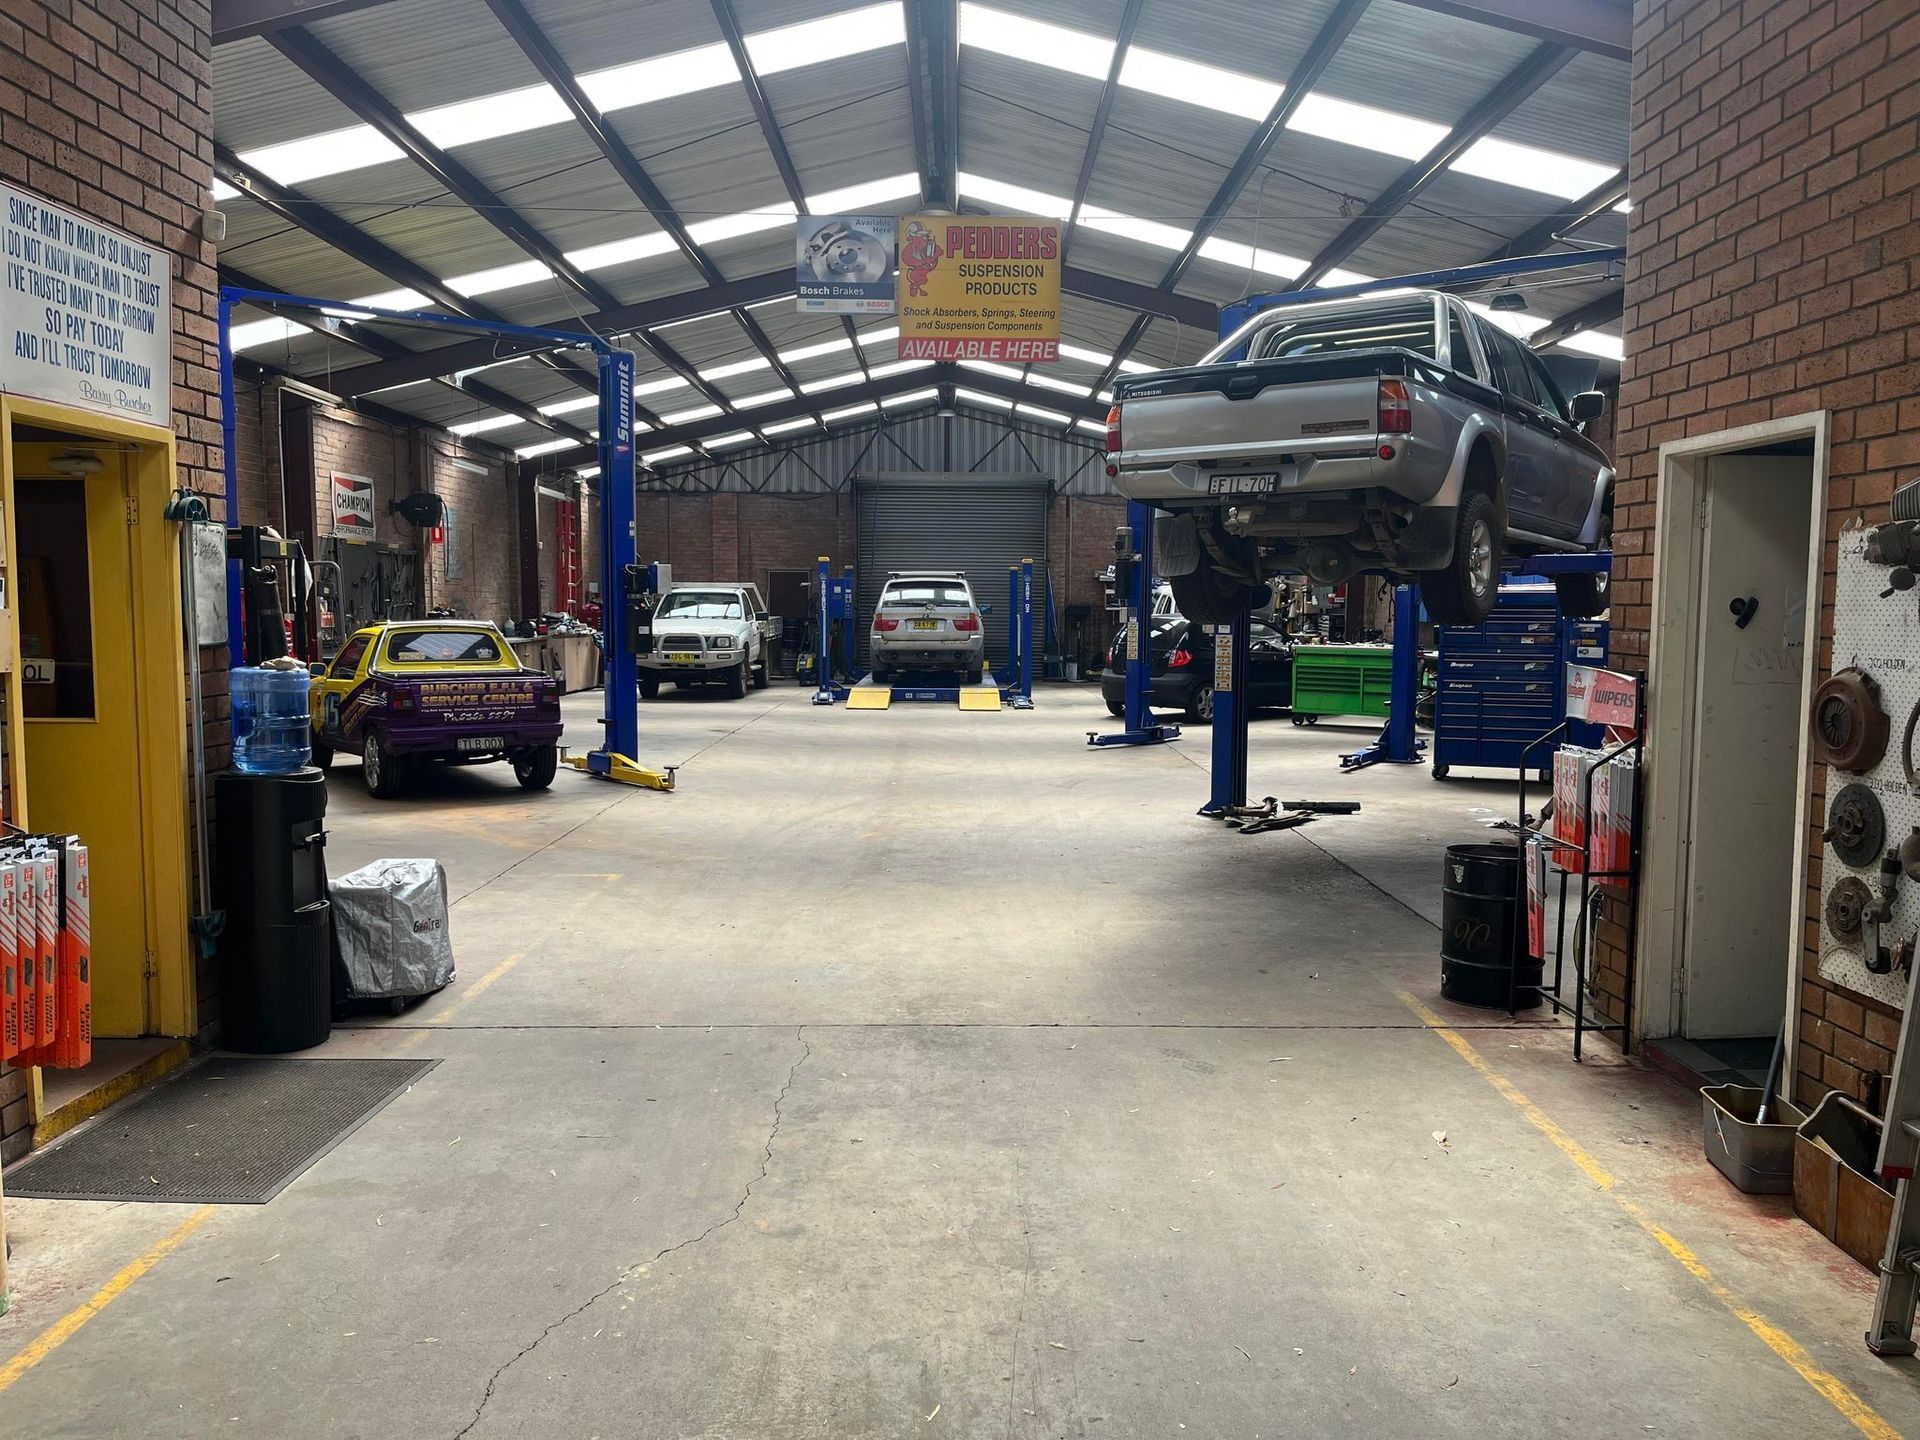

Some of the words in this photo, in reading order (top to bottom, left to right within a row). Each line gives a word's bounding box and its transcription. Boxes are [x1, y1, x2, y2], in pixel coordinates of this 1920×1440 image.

[10, 196, 37, 232] SINCE
[41, 209, 60, 241] MAN
[64, 219, 74, 246] TO
[77, 225, 95, 255] MAN
[98, 233, 106, 259] IS
[108, 238, 118, 264] SO
[121, 243, 151, 276] UNJUST
[946, 226, 1057, 260] PEDDERS
[2, 226, 5, 252] I
[8, 229, 20, 258] DO
[24, 235, 41, 265] NOT
[45, 243, 70, 276] KNOW
[73, 254, 99, 287] WHICH
[103, 266, 119, 294] MAN
[122, 273, 132, 298] TO
[134, 278, 160, 307] TRUST
[959, 264, 1044, 278] SUSPENSION
[8, 261, 25, 292] I'VE
[28, 268, 66, 305] TRUSTED
[70, 284, 92, 314] MANY
[96, 293, 105, 318] TO
[109, 298, 119, 323] MY
[123, 303, 154, 334] SORROW
[800, 286, 830, 295] Bosch
[832, 287, 864, 296] Brakes
[965, 282, 1037, 296] PRODUCTS
[903, 307, 931, 317] Shock
[933, 308, 979, 319] Absorbers,
[982, 308, 1017, 319] Springs,
[1019, 309, 1056, 320] Steering
[45, 307, 61, 334] SO
[66, 313, 86, 342] PAY
[90, 321, 124, 353] TODAY
[916, 321, 933, 330] and
[935, 321, 985, 332] Suspension
[987, 322, 1043, 333] Components
[15, 330, 38, 360] AND
[42, 337, 61, 366] I'LL
[64, 343, 95, 375] TRUST
[99, 353, 151, 389] TOMORROW
[903, 340, 1001, 359] AVAILABLE
[1005, 341, 1056, 360] HERE
[79, 380, 111, 408] Barry
[617, 361, 629, 443] Summit
[337, 493, 371, 513] CHAMPION
[421, 684, 485, 694] BURCHER
[1595, 690, 1635, 708] WIPERS
[421, 695, 479, 706] SERVICE
[482, 693, 534, 704] CENTRE
[413, 917, 442, 932] GenTra
